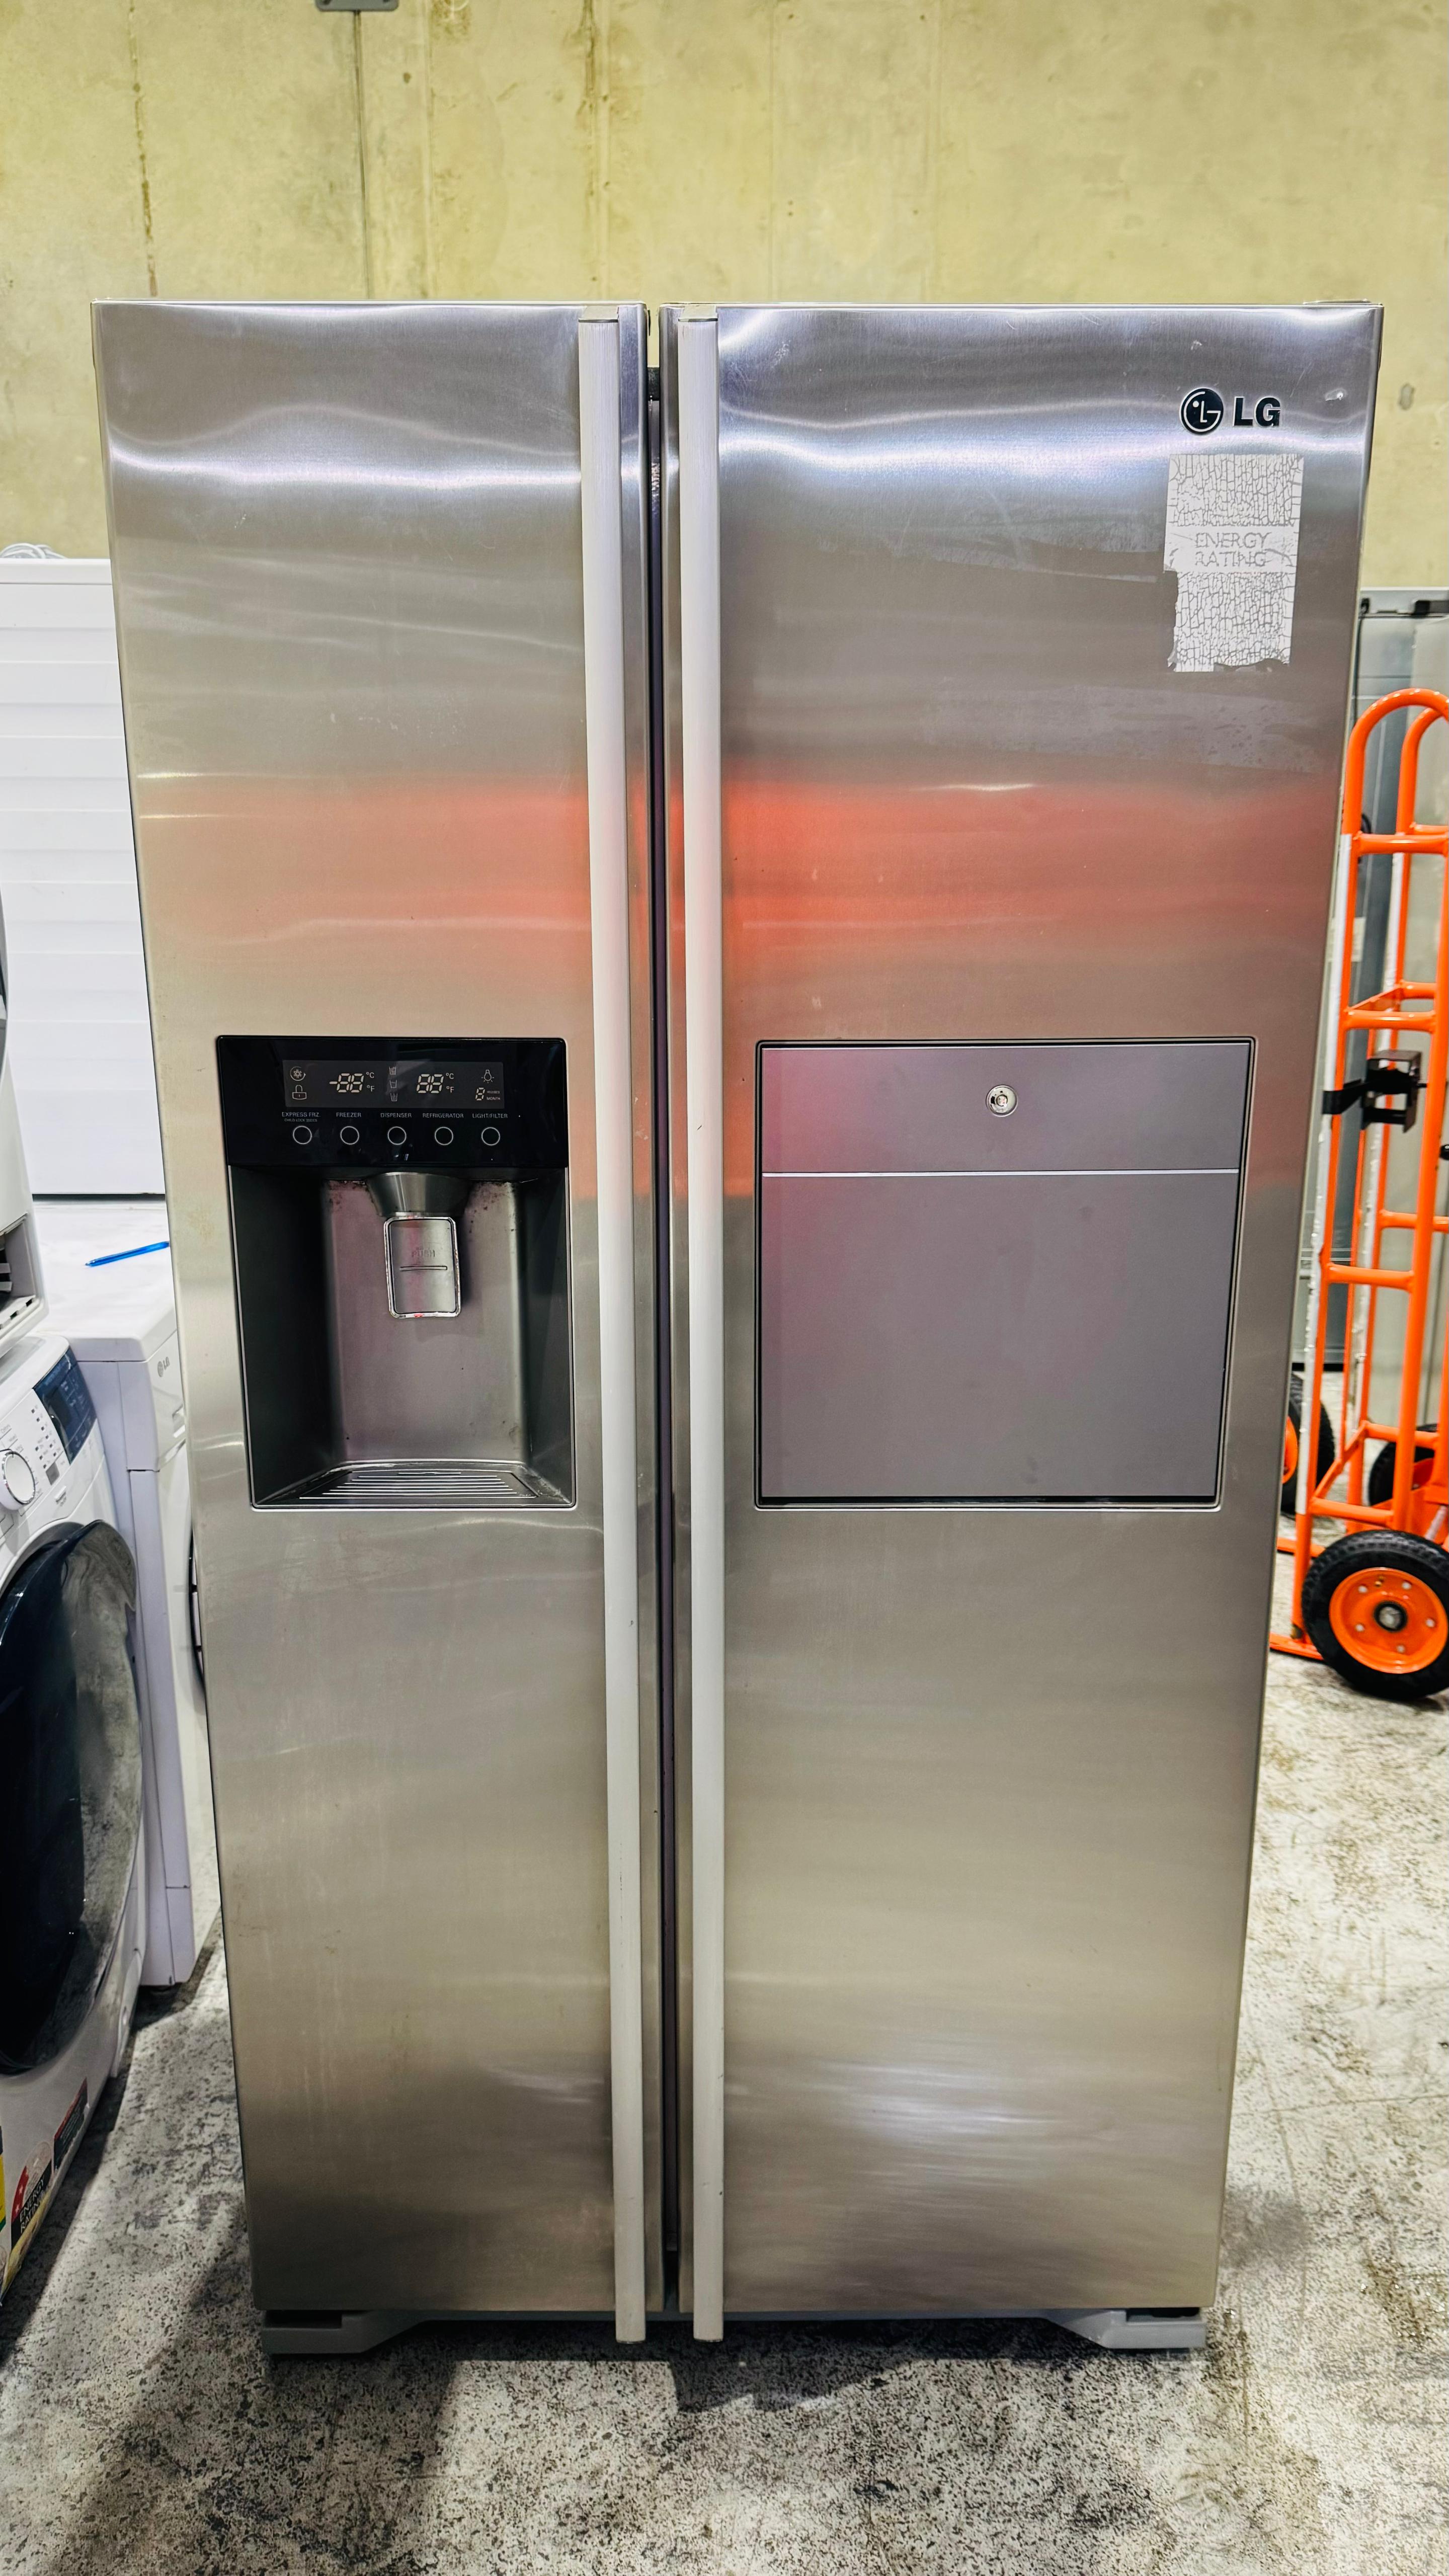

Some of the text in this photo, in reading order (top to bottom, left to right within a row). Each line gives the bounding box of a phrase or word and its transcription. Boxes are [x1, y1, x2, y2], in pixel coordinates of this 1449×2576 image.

[1233, 396, 1281, 427] LG
[1195, 532, 1272, 548] ENERGY
[1195, 551, 1267, 567] RATING
[417, 1074, 444, 1093] 88
